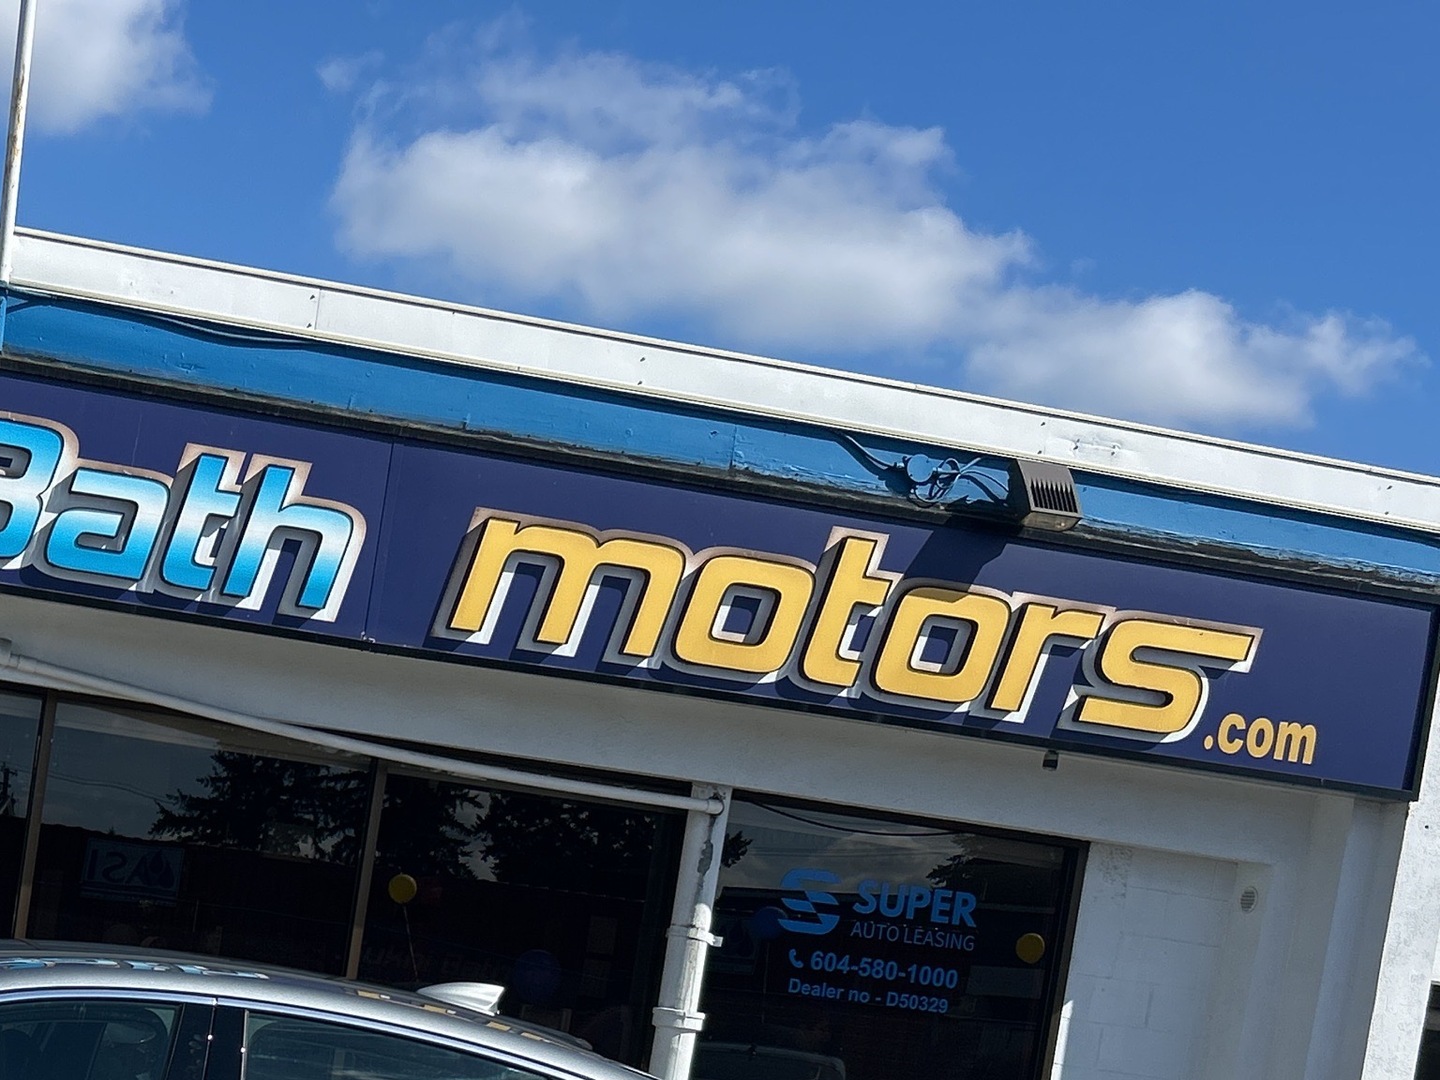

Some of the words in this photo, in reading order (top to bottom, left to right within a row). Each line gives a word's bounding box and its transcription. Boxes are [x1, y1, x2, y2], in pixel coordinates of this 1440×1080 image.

[429, 506, 1264, 743] motors
[852, 879, 978, 928] SUPER
[850, 920, 900, 942] AUTO
[903, 928, 976, 951] LEASING
[810, 951, 959, 989] 604-580-1000
[787, 978, 844, 1000] Dealer
[848, 989, 870, 1003] no
[885, 991, 949, 1014] D50329
